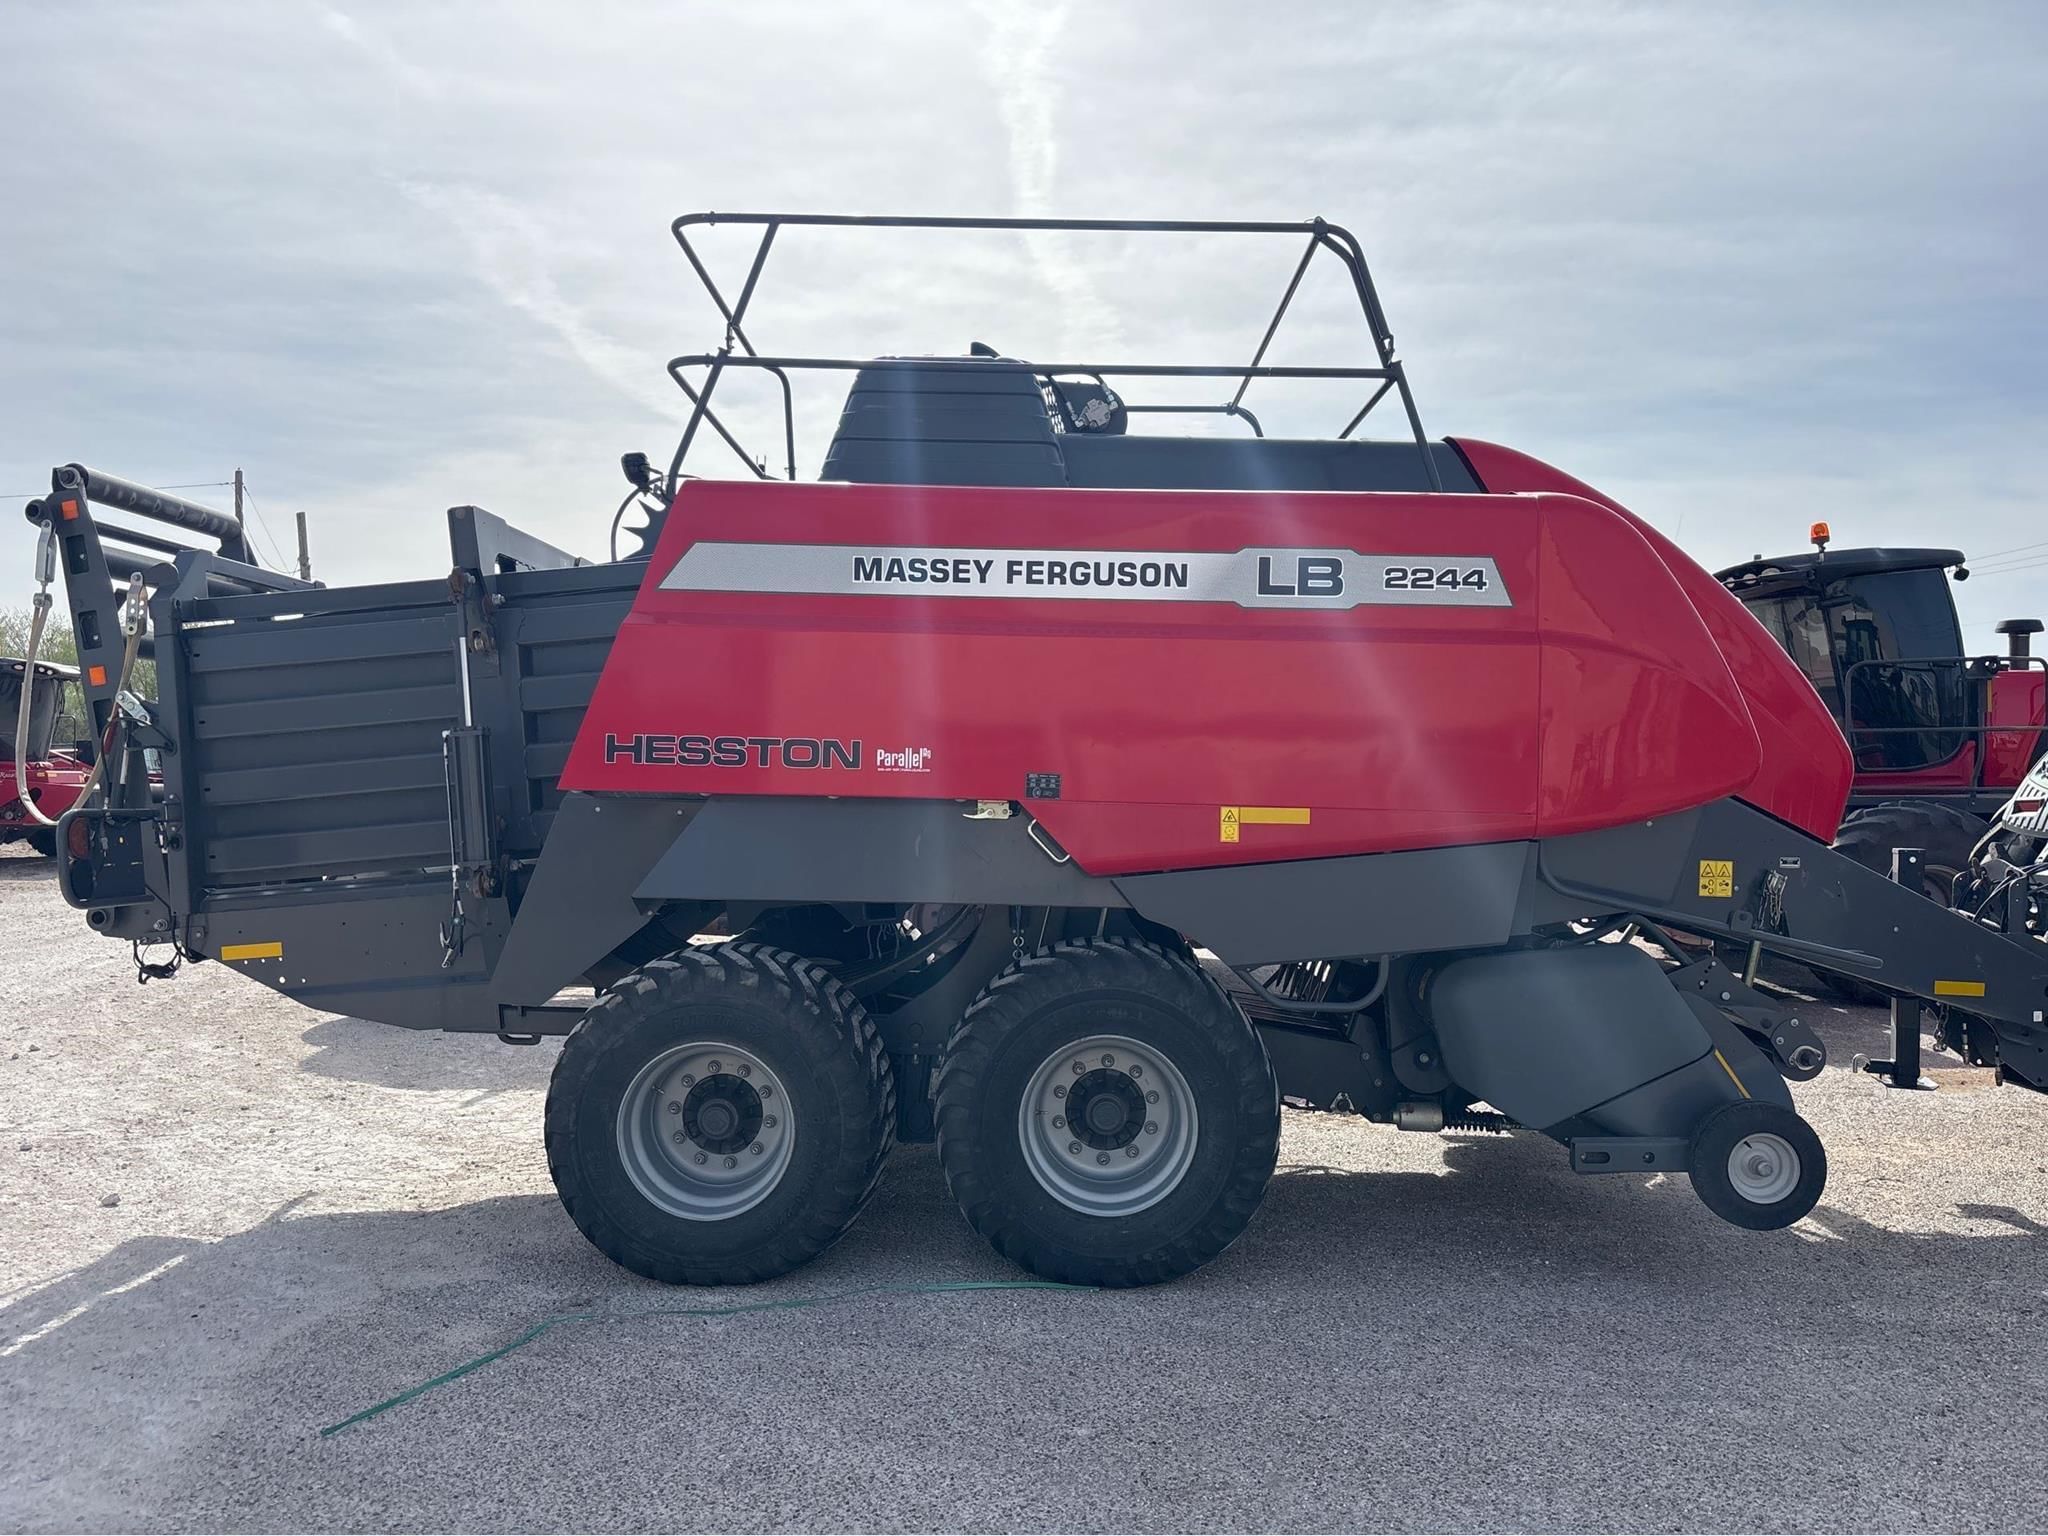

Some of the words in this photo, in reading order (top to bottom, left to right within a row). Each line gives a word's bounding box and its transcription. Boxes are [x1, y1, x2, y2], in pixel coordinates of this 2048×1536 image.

[852, 556, 994, 584] MASSEY
[1005, 559, 1188, 588] FERGUSON
[1257, 555, 1344, 598] LB
[1384, 566, 1488, 592] 2244
[604, 733, 862, 770] HESSTON
[876, 747, 923, 769] Parallel
